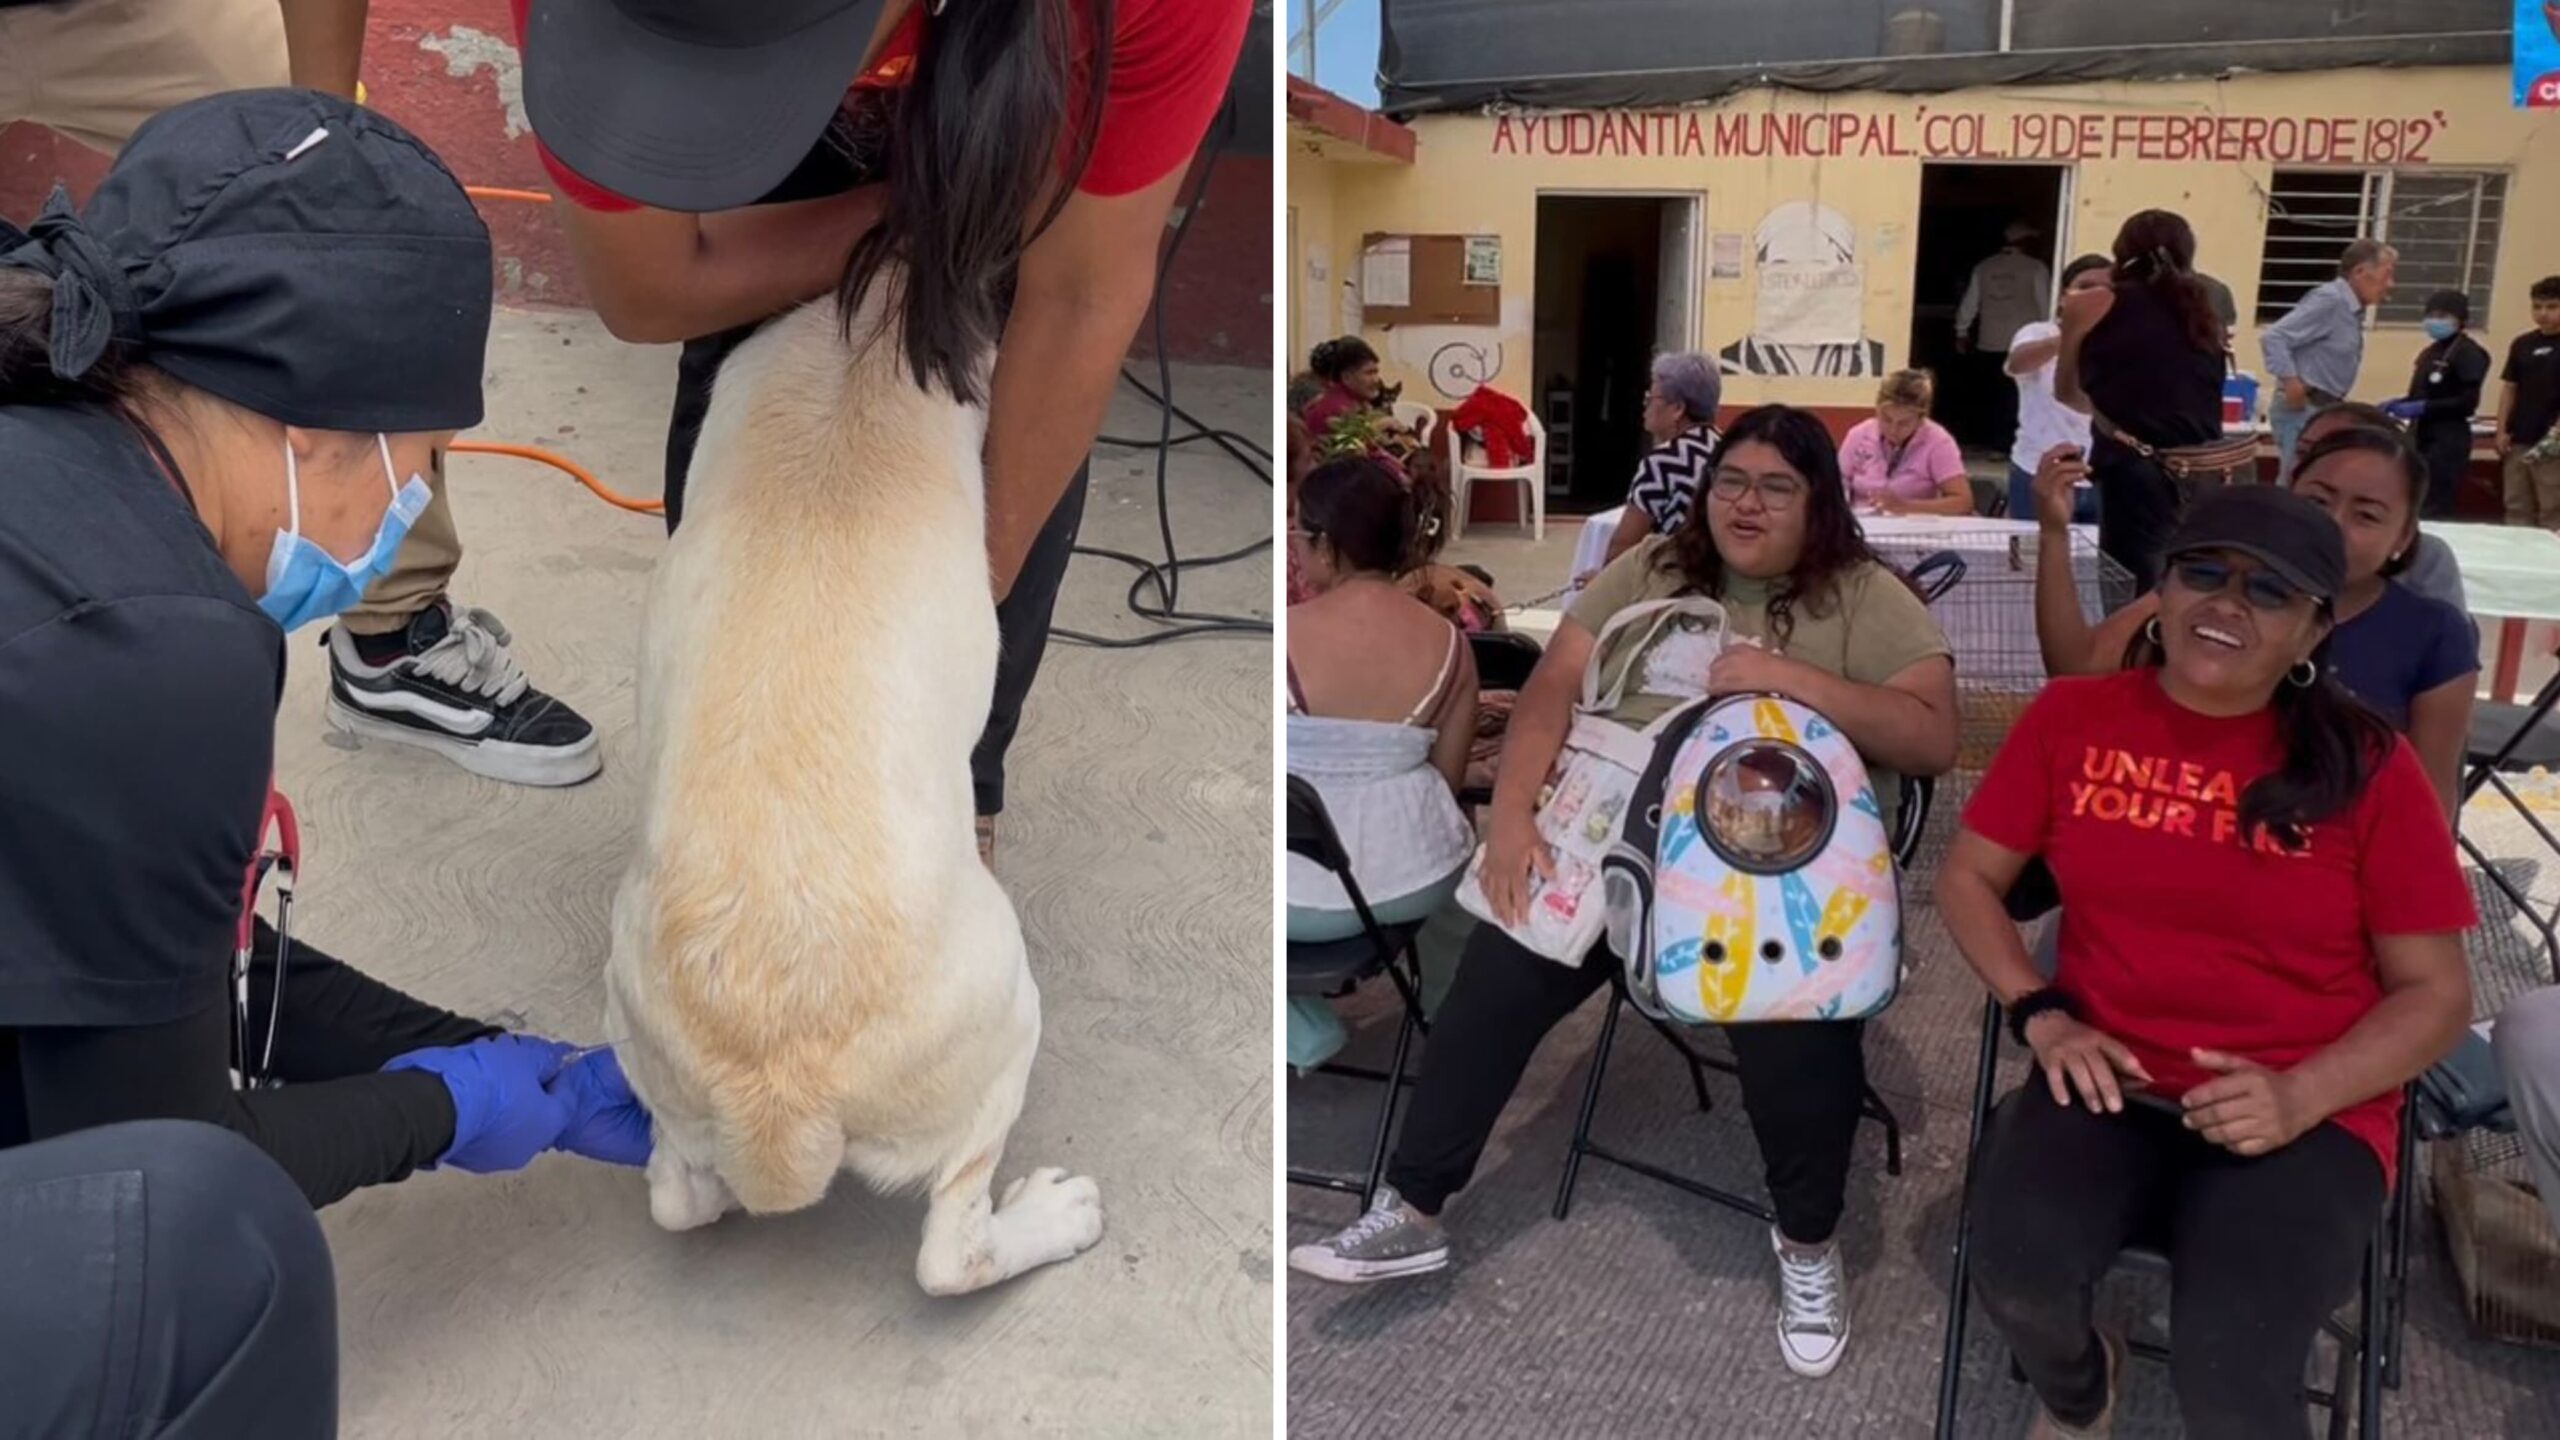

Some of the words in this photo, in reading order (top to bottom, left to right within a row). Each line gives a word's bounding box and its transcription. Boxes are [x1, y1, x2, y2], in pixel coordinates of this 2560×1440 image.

[1492, 113, 1705, 156] AYUDANTIA
[2010, 113, 2048, 159] 19
[2051, 114, 2104, 160] DE
[2110, 115, 2298, 161] FEBRERO
[2302, 117, 2357, 162] DE
[2083, 746, 2238, 806] UNLEA
[2070, 781, 2197, 837] YOUR
